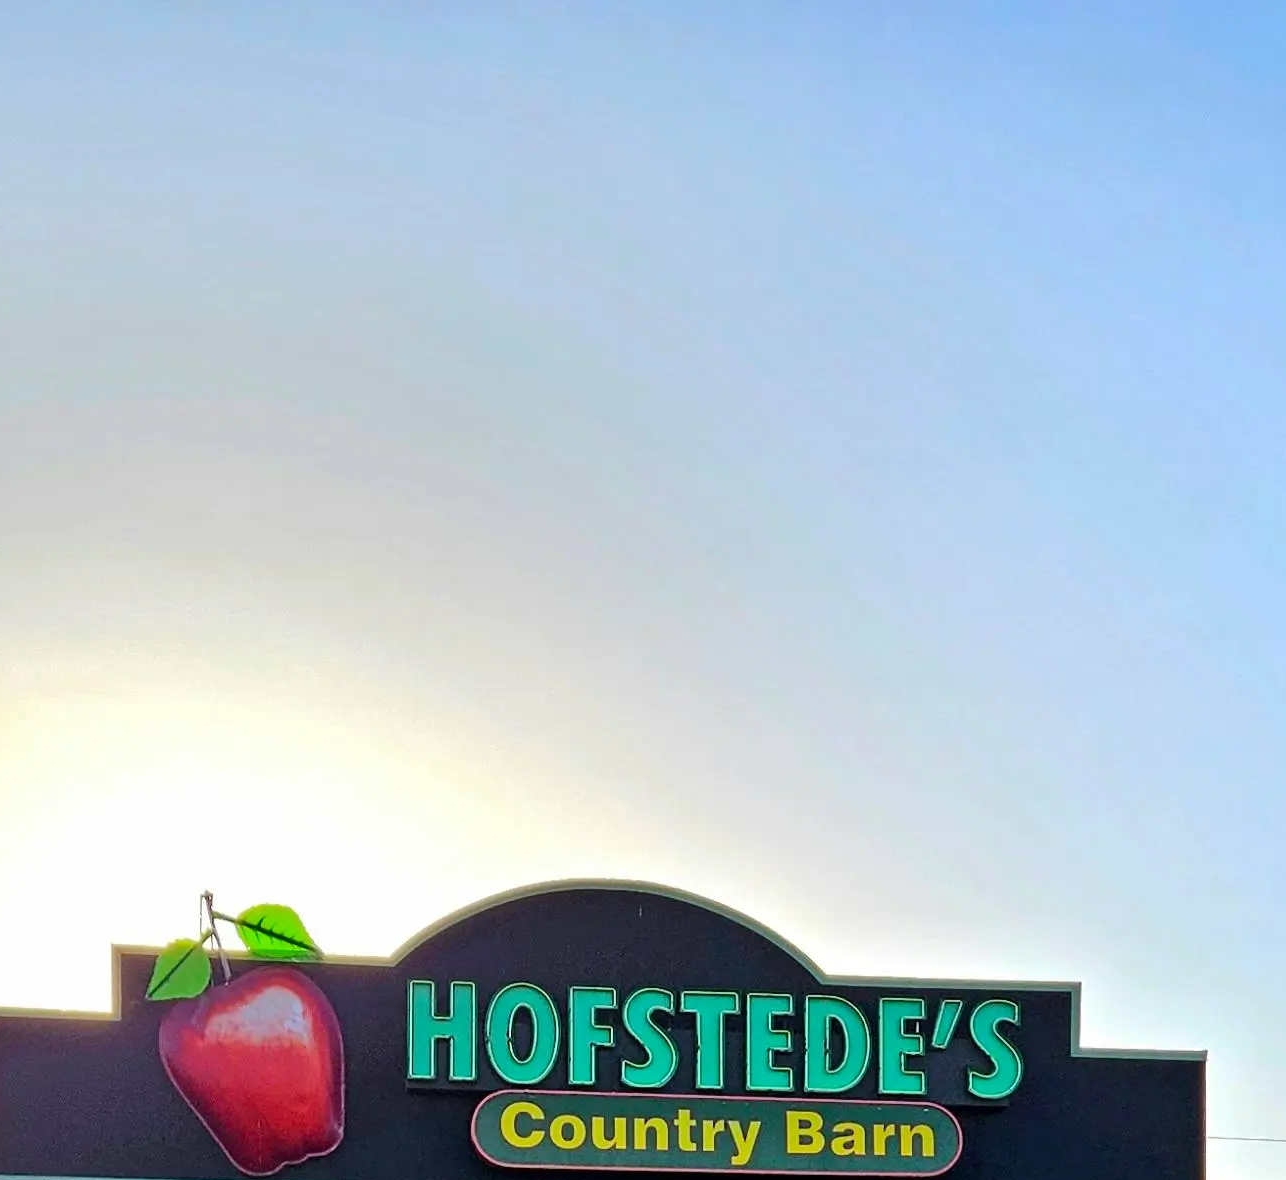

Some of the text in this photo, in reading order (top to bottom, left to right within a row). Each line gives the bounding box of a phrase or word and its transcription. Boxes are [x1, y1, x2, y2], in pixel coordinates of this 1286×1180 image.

[407, 979, 1024, 1100] HOFSTEDE'S
[500, 1101, 935, 1165] Country Barn
